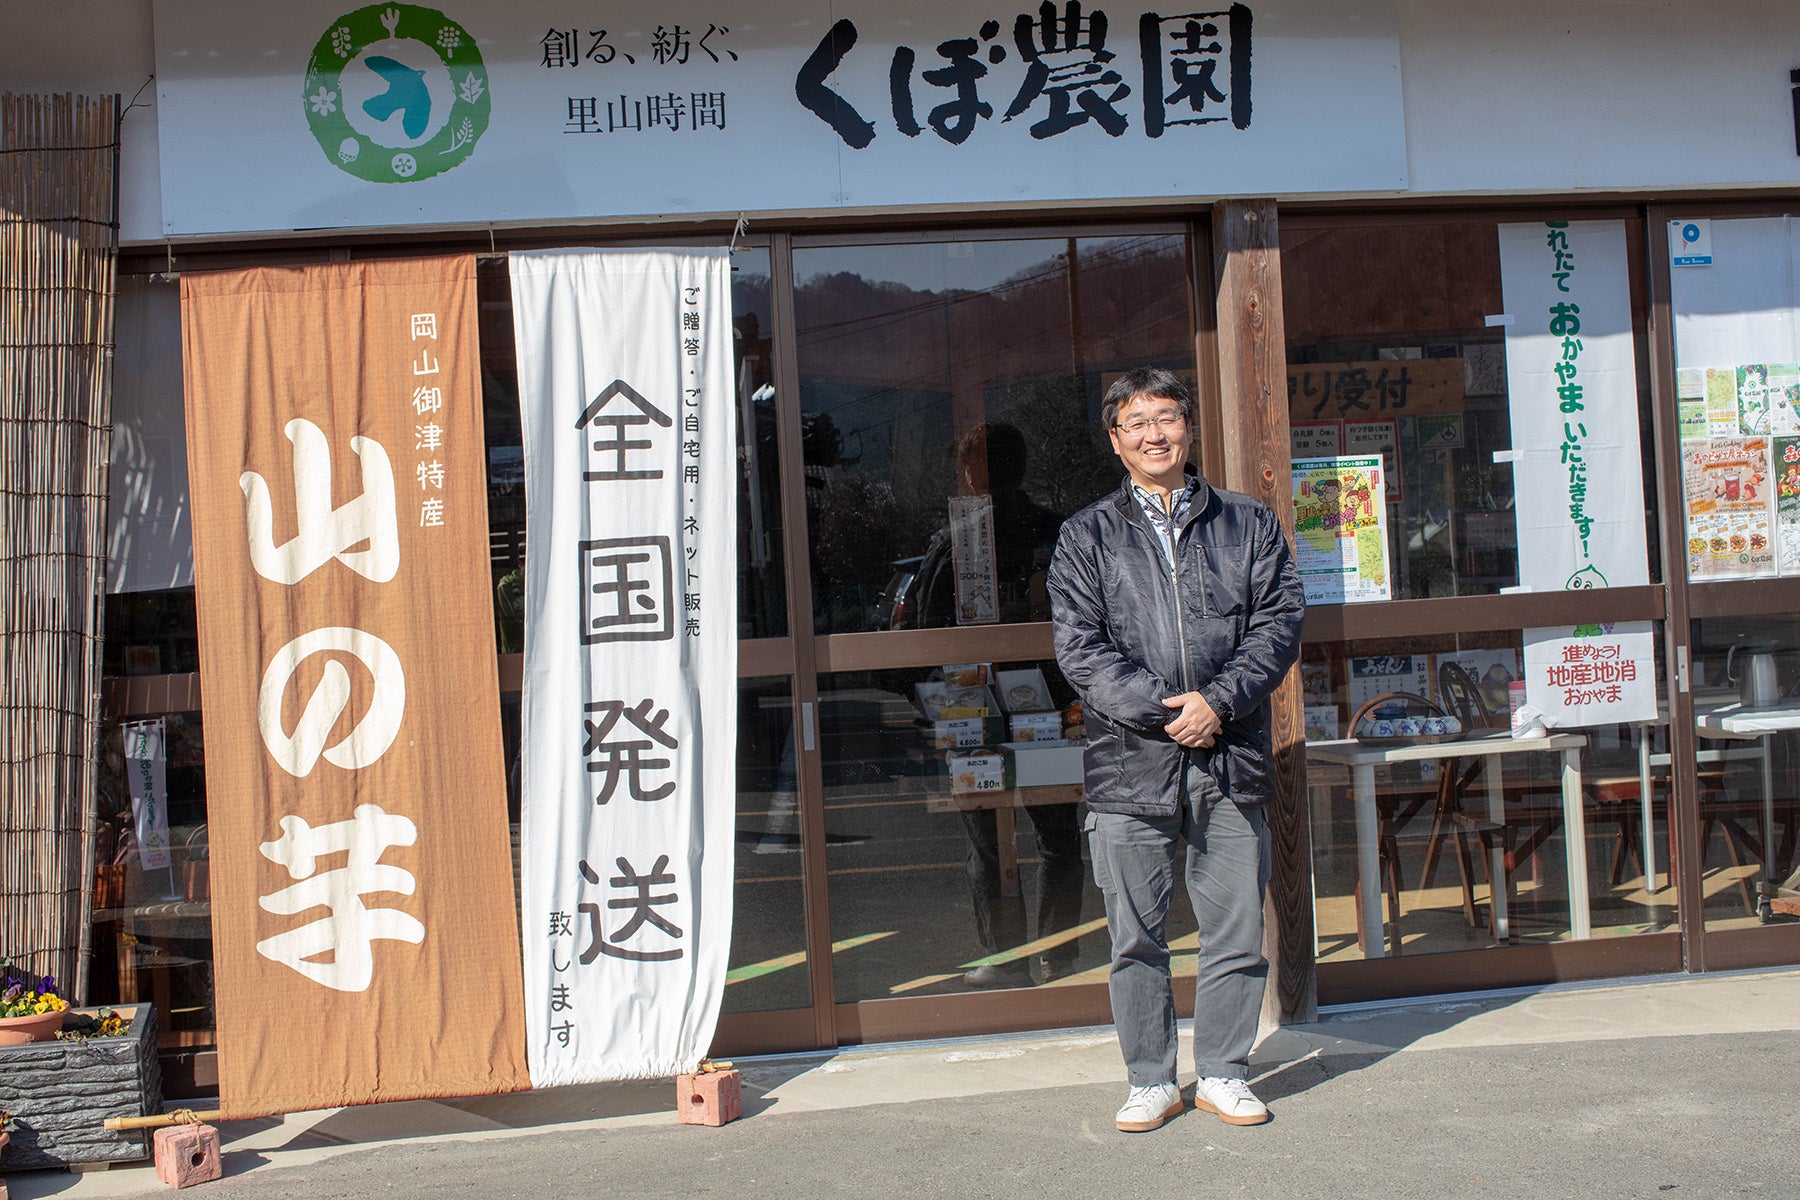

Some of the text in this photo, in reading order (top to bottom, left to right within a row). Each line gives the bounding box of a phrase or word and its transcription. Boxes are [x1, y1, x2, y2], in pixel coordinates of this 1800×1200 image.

[540, 24, 740, 69] 創る、紡ぐ、
[563, 92, 727, 135] 里山時間
[796, 0, 1253, 150] くぼ農園
[410, 312, 446, 529] 岡山御津特産
[1549, 301, 1584, 413] おかやま
[682, 285, 702, 638] ご贈答・ご自宅用・ネット販売
[239, 418, 426, 992] 山の芋
[574, 378, 685, 966] 全国発送
[1547, 660, 1637, 687] 地産地消
[1564, 685, 1623, 706] おかやま
[549, 910, 575, 1049] 致します
